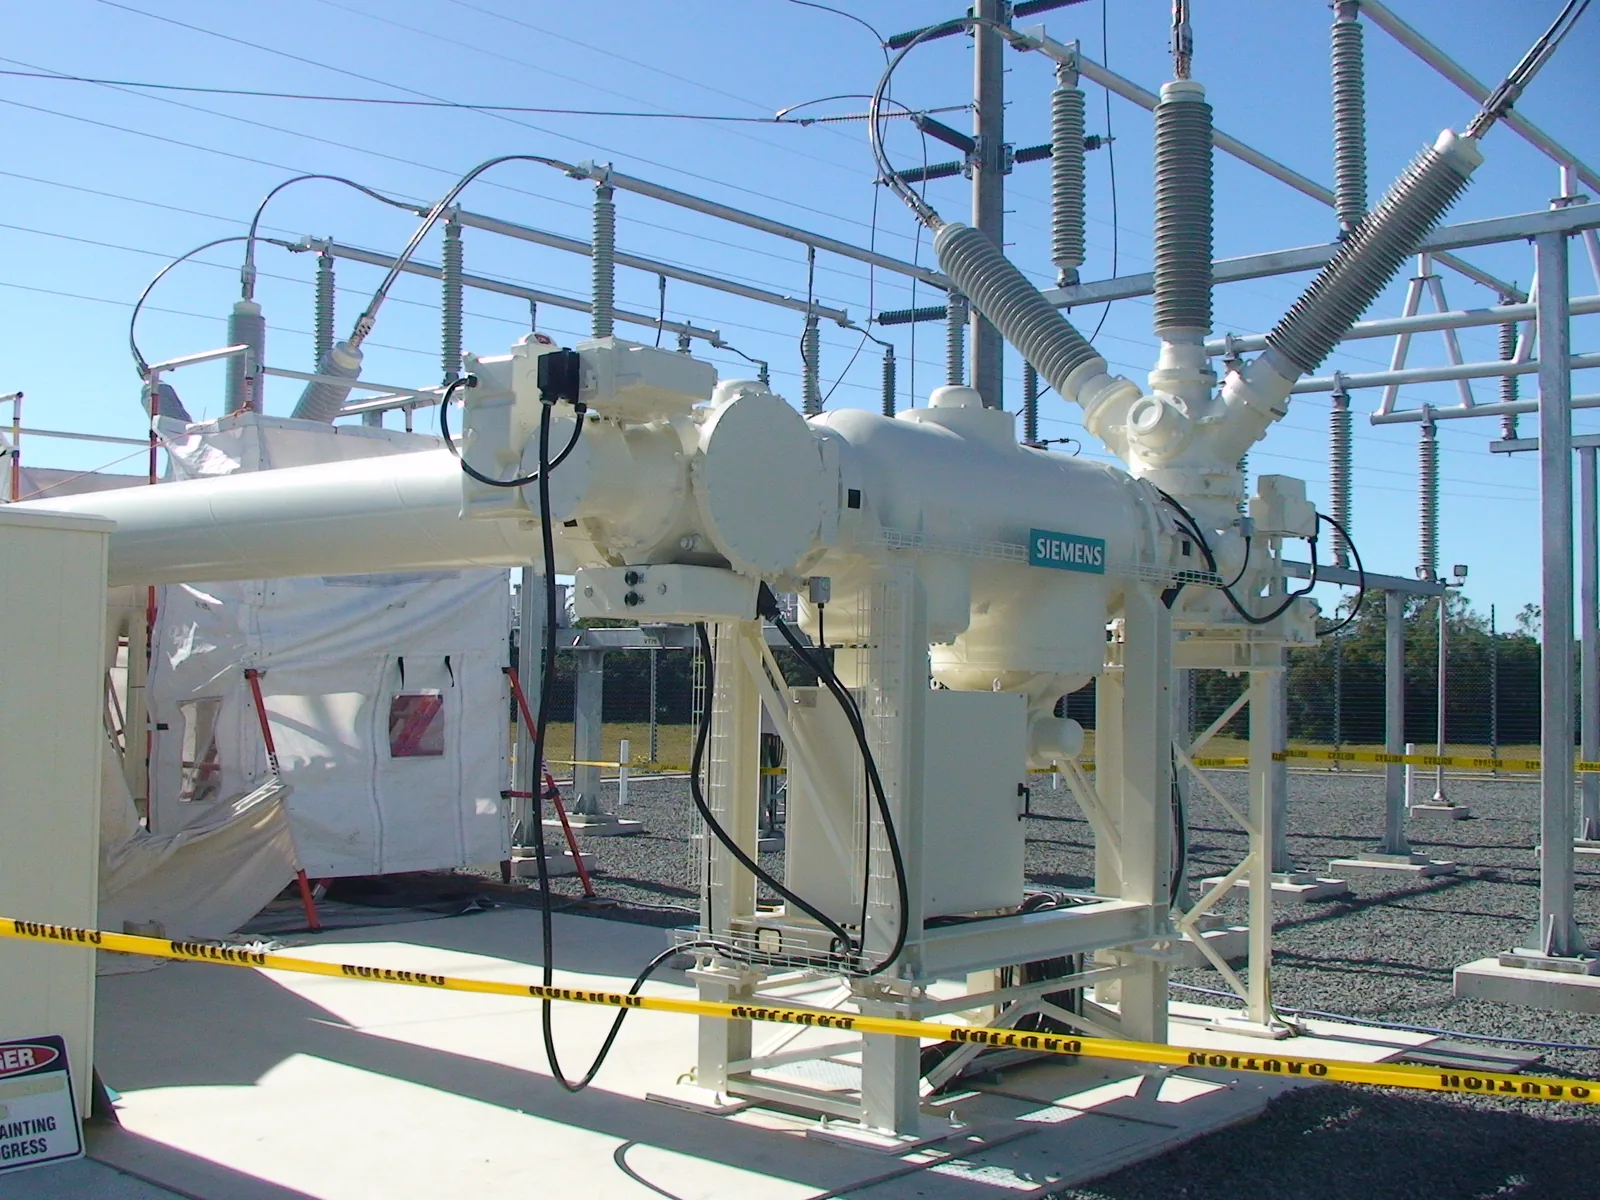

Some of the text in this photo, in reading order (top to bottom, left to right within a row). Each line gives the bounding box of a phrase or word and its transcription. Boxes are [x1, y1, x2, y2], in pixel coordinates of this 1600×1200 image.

[1036, 538, 1102, 566] SIEMENS
[14, 920, 102, 945] CAUTION
[170, 941, 265, 965] CAUTION
[341, 964, 445, 986] CAUTION
[951, 1028, 1082, 1053] CAUTION
[1188, 1051, 1328, 1076] CAUTION
[1441, 1074, 1590, 1098] CAUTION
